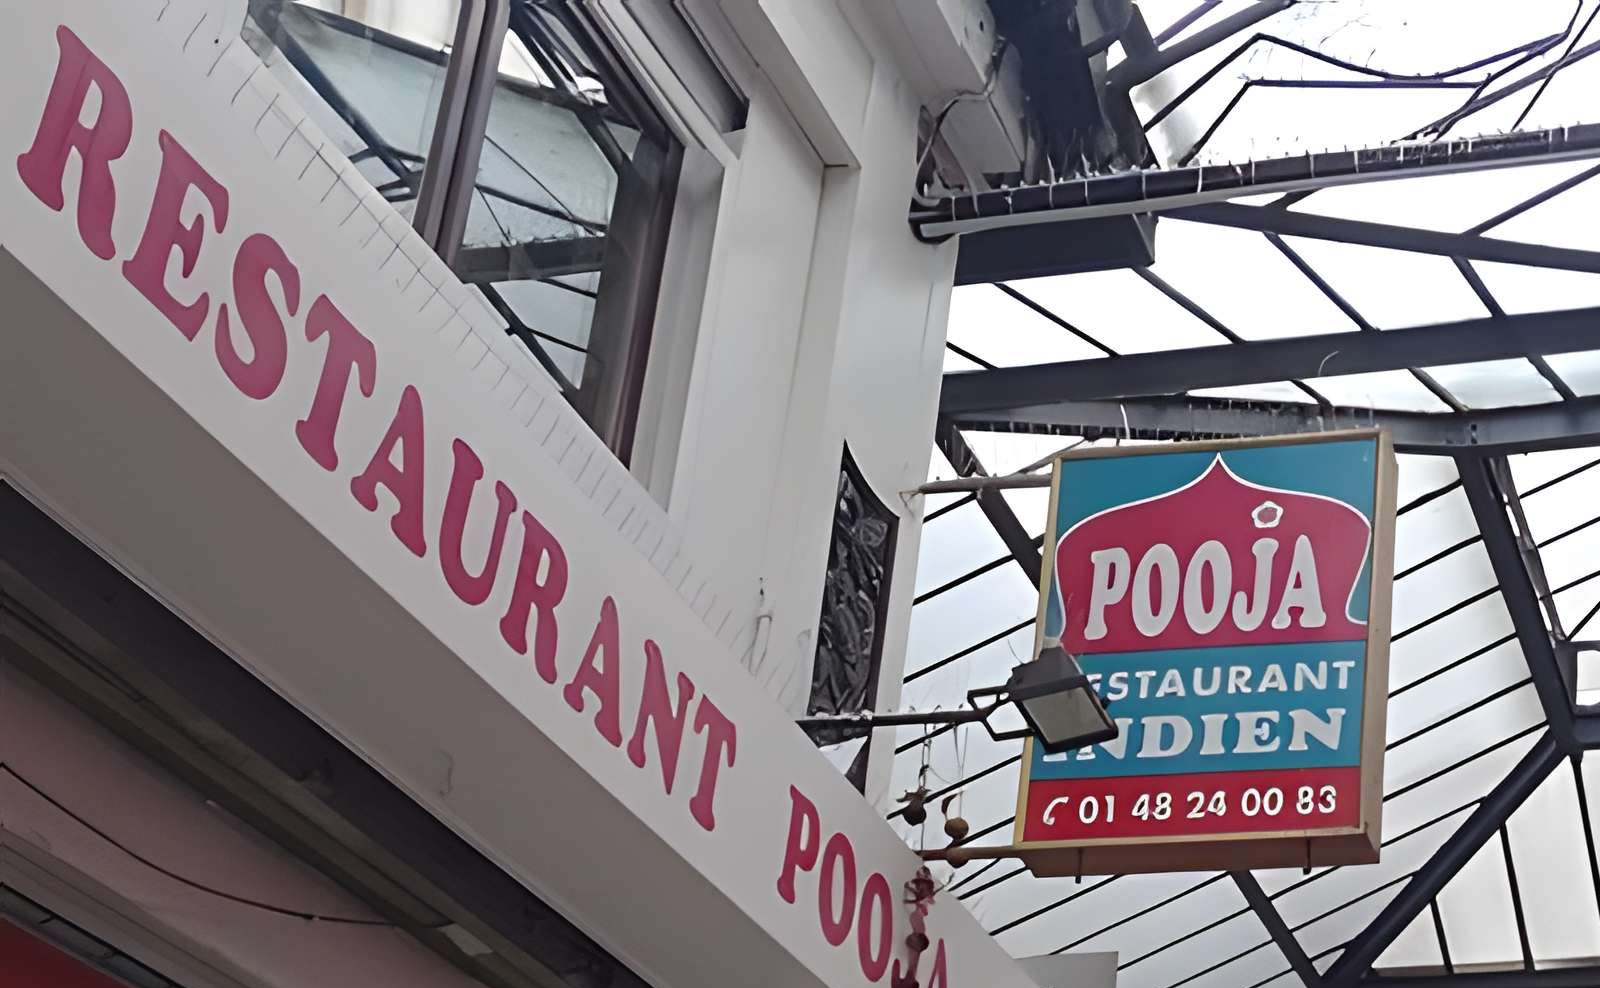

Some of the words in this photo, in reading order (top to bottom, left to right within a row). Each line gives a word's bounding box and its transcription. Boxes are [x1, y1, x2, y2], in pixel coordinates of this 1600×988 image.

[16, 24, 737, 832] RESTAURANT
[1083, 534, 1327, 640] POOJA
[1086, 661, 1356, 701] STAURANT
[1043, 708, 1347, 762] NDIEN
[1078, 795, 1114, 824] 01
[1131, 792, 1172, 821] 48
[1186, 791, 1226, 819] 24
[1241, 788, 1284, 816] 00
[1296, 785, 1336, 814] 83
